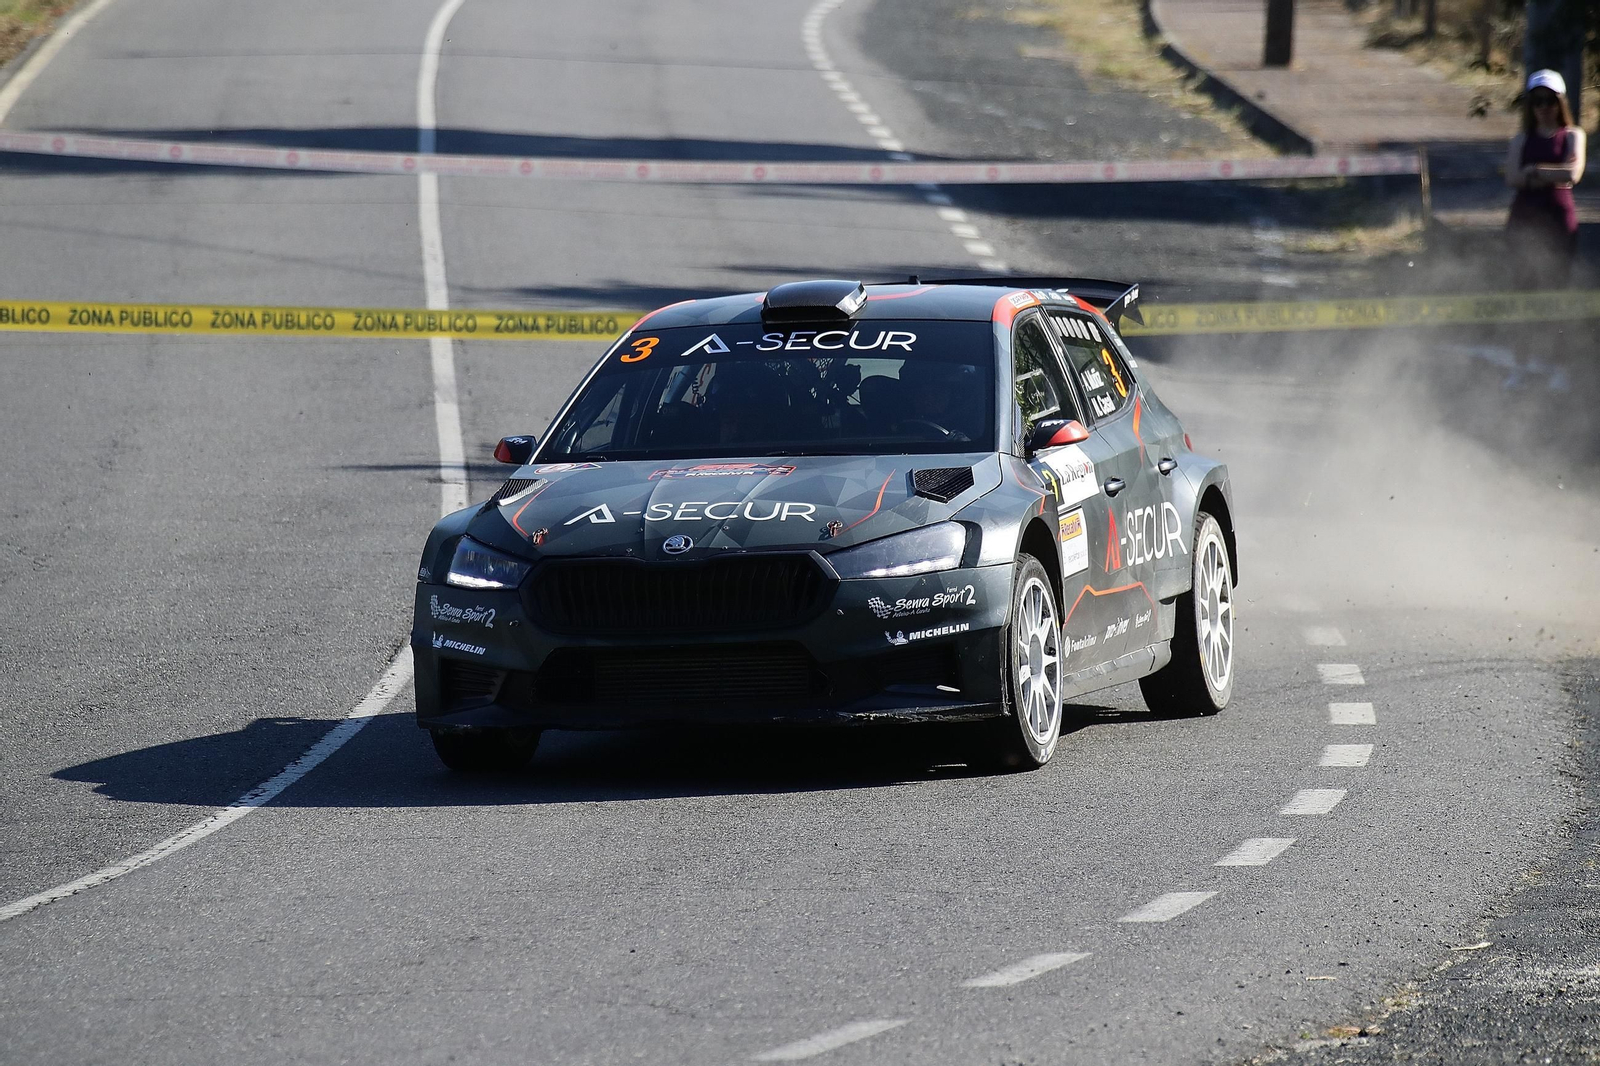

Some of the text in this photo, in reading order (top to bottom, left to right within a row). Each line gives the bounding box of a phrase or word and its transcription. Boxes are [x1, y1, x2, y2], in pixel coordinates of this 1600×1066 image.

[68, 308, 115, 326] ZONA
[119, 309, 193, 328] PUBLICO
[210, 310, 257, 329] ZONA
[261, 312, 335, 331] PUBLICO
[353, 313, 397, 332] ZONA
[403, 314, 477, 333] PUBLICO
[494, 315, 538, 334] ZONA
[545, 316, 618, 335] PUBLICO
[620, 337, 660, 363] 3
[1101, 348, 1128, 398] 3
[894, 584, 977, 612] Senra Sport 2
[440, 603, 463, 617] Senra
[462, 608, 488, 623] Sport
[909, 622, 970, 641] MICHELIN
[443, 639, 486, 655] MICHELIN
